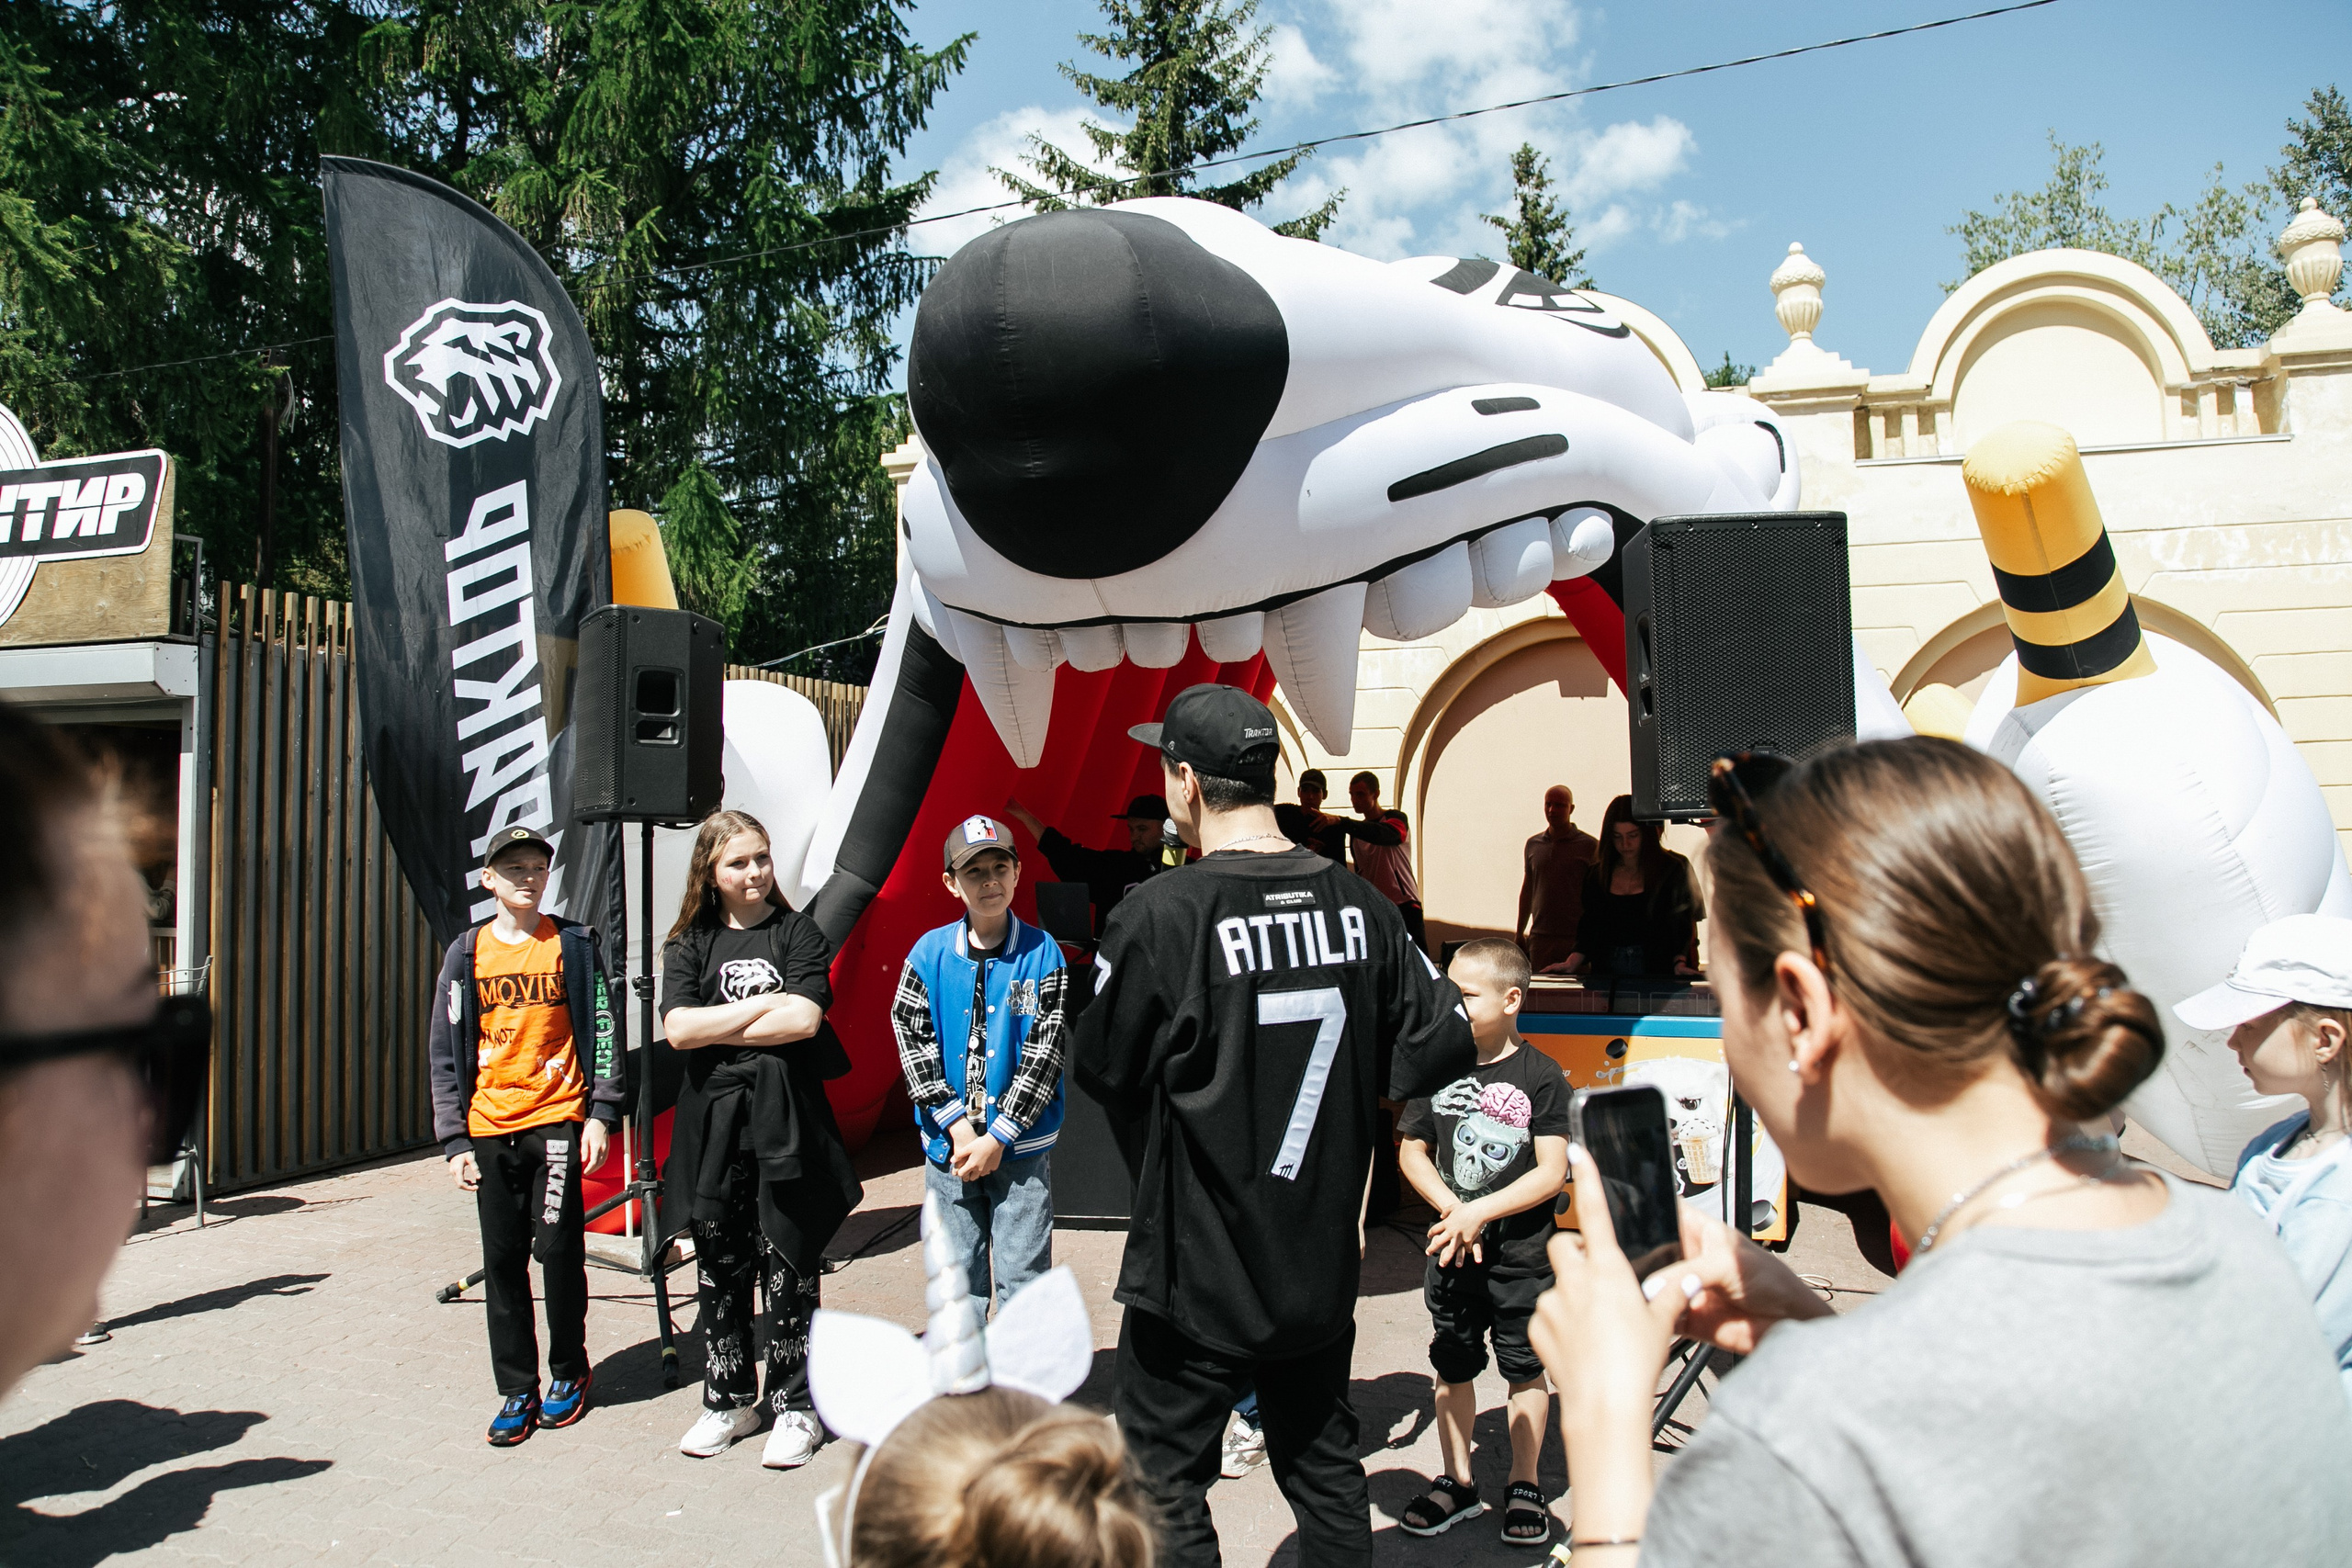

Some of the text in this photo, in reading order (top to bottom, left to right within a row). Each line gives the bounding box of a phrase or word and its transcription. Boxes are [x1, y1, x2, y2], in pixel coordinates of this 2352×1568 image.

[1265, 890, 1314, 901] ATRIBUTIKA
[1216, 906, 1368, 976] ATTILA
[1257, 987, 1347, 1181] 7
[1512, 1488, 1538, 1500] SPORT
